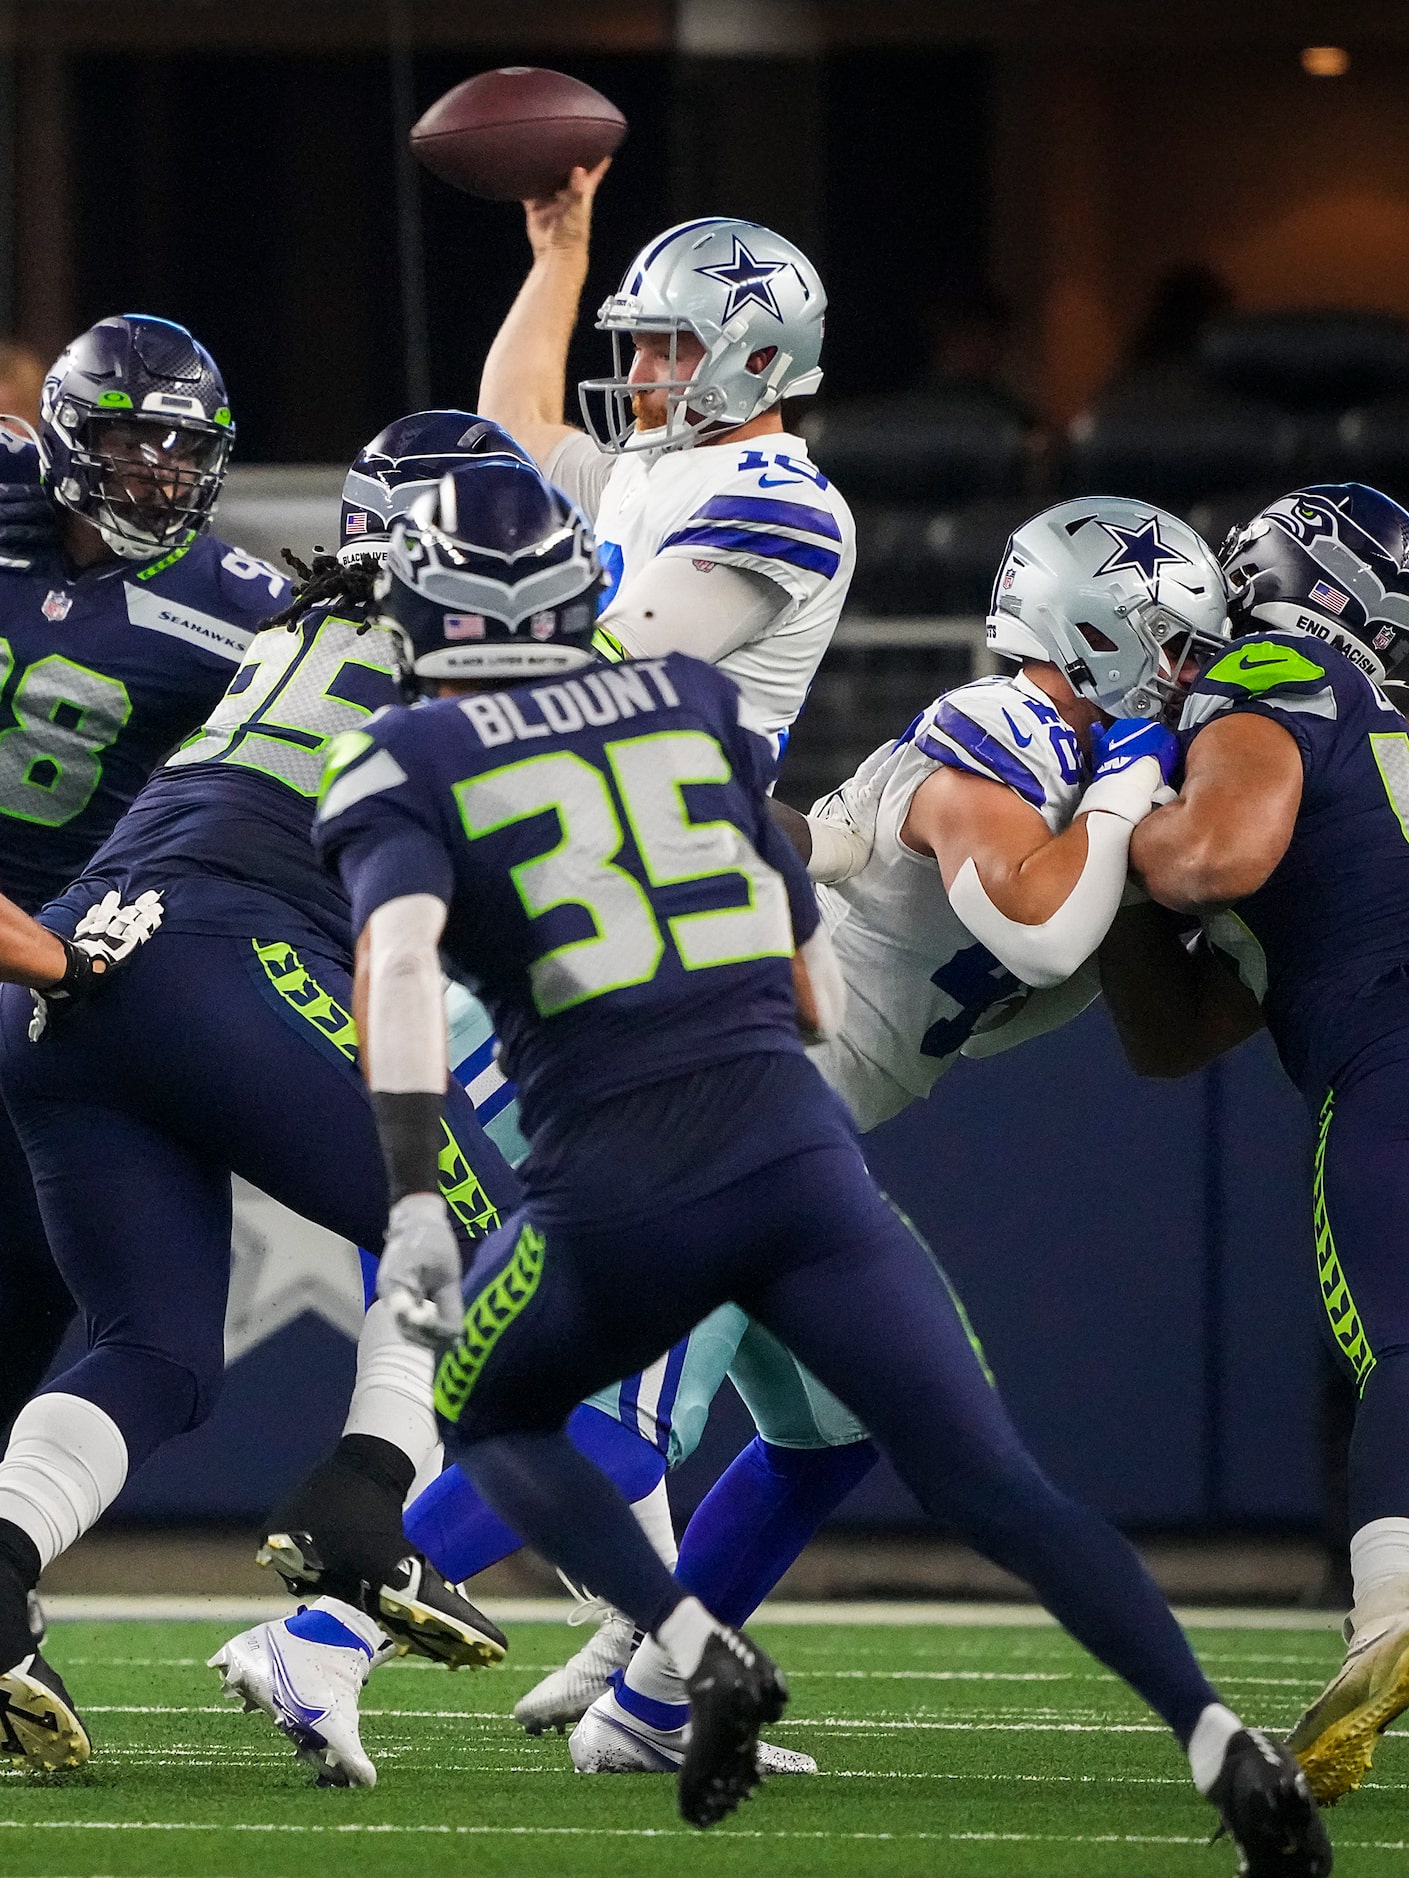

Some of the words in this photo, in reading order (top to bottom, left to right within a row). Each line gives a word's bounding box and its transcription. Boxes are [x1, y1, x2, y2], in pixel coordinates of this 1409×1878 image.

[157, 609, 246, 652] SEAHAWKS
[1295, 615, 1331, 641] END
[1330, 634, 1378, 676] ACISM
[458, 660, 681, 749] BLOUNT
[451, 729, 796, 1017] 35
